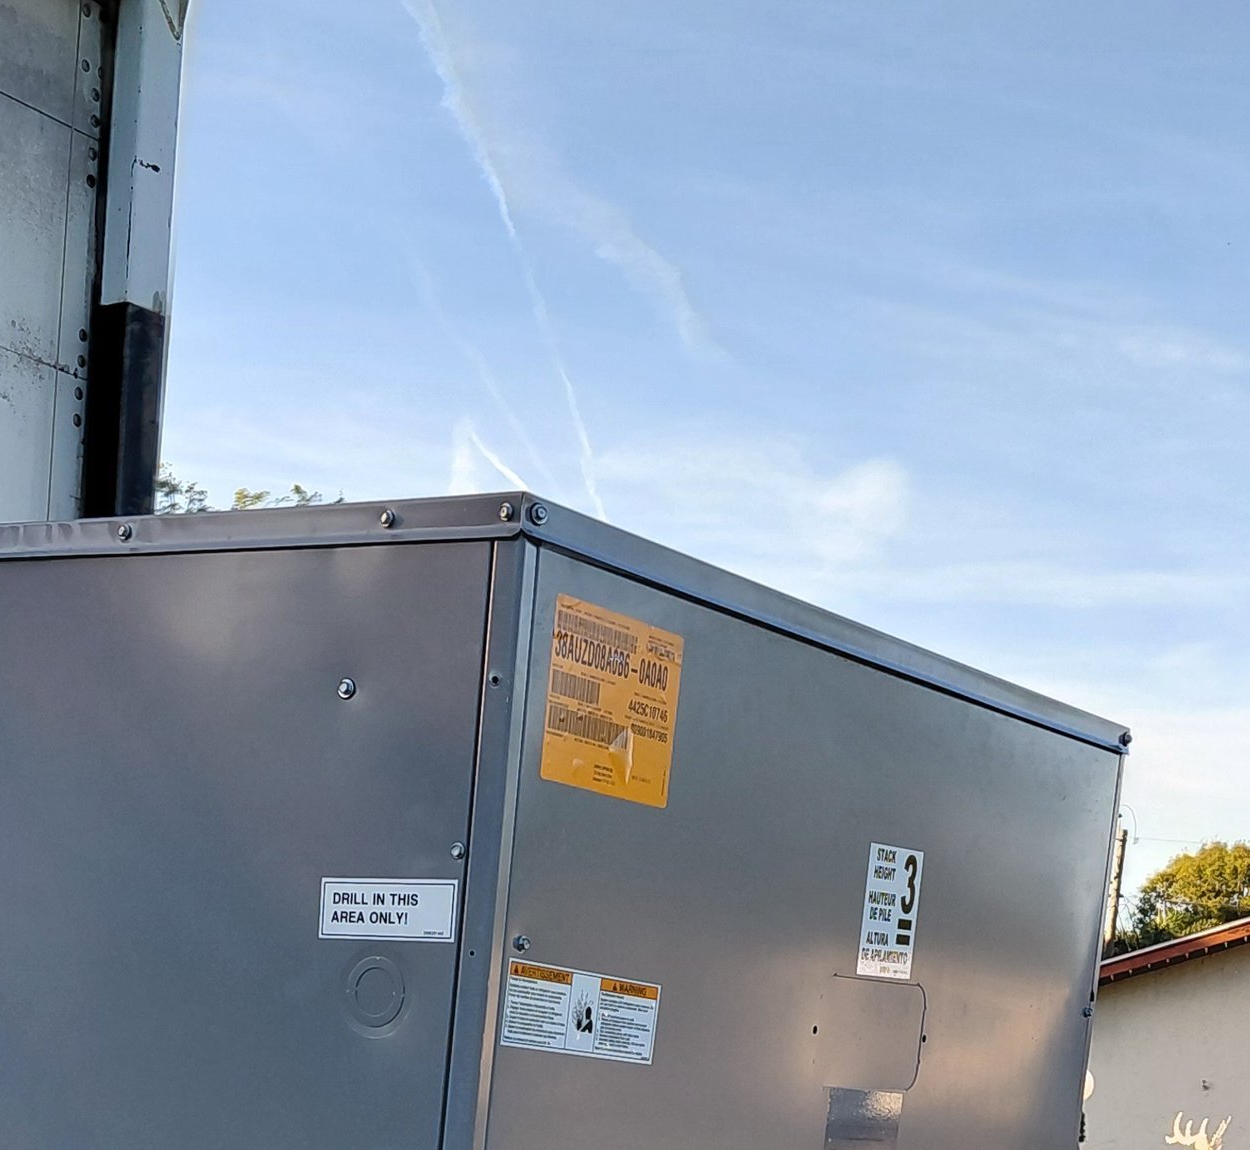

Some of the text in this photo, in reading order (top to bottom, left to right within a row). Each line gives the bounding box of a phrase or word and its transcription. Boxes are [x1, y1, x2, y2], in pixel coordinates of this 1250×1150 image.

[876, 848, 897, 864] STACK
[873, 865, 896, 881] HEIGHT
[900, 854, 918, 915] 3
[332, 892, 419, 907] DRILL IN THIS
[868, 890, 897, 907] HAUTEUR
[331, 911, 408, 925] AREA ONLY!
[869, 906, 892, 922] DE PILE
[865, 931, 889, 947] ALTURA
[520, 966, 570, 983] AVERTISSEMENT
[618, 985, 647, 997] WARNING
